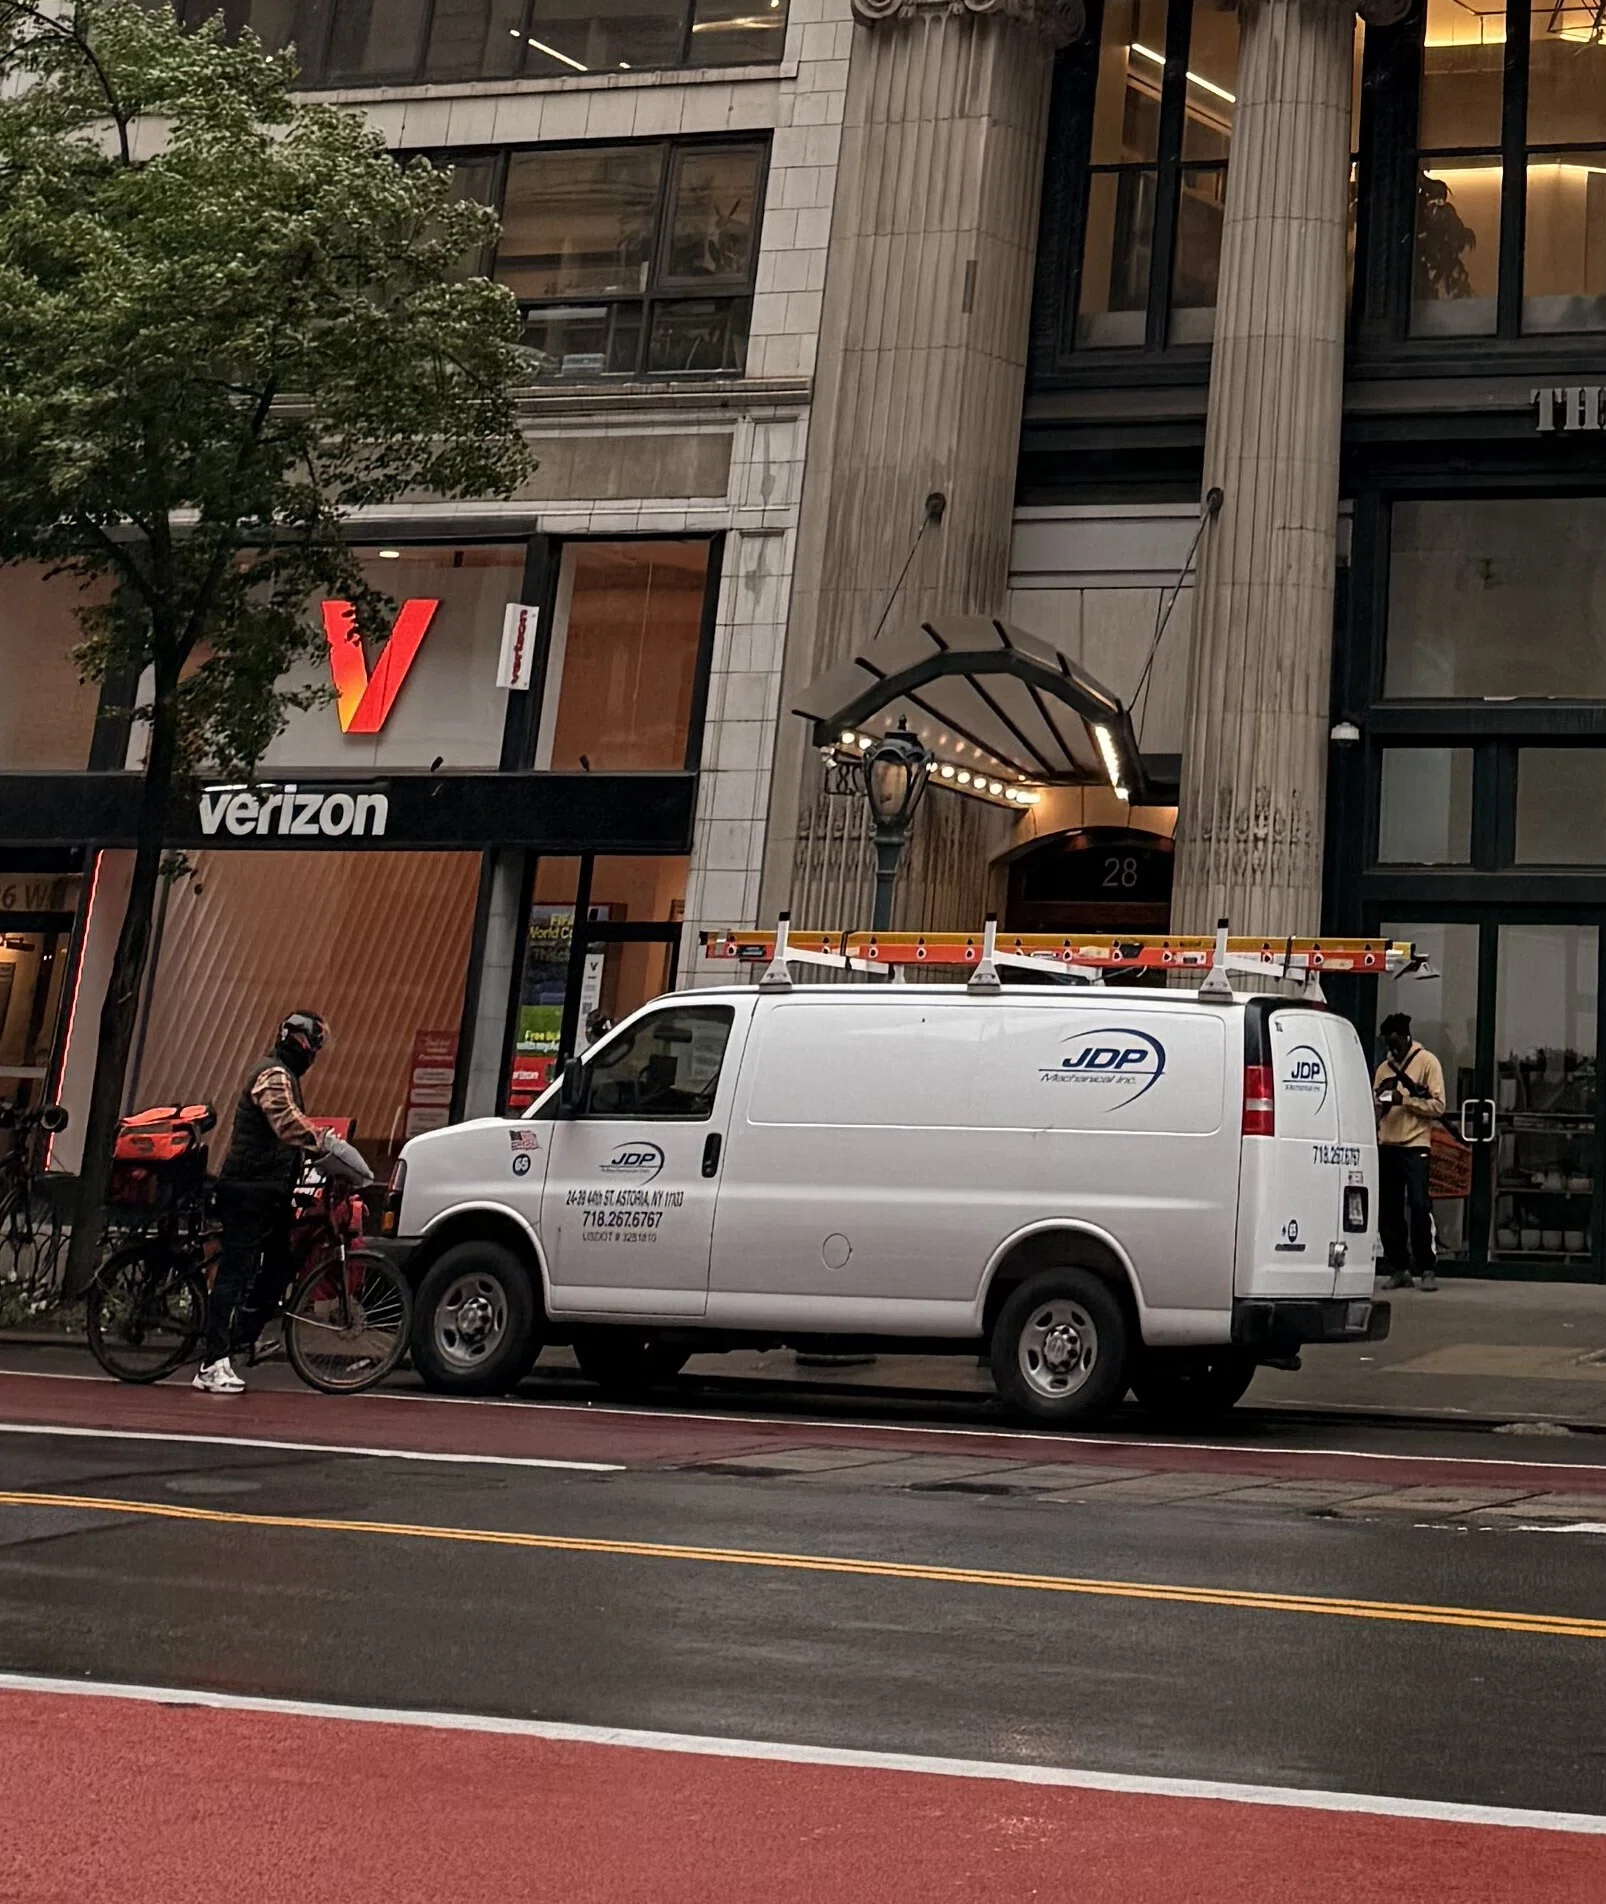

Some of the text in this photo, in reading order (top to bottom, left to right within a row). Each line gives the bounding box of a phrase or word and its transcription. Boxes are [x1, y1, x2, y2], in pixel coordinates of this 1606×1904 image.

[199, 784, 389, 836] verizon
[1102, 857, 1137, 888] 28
[1061, 1047, 1149, 1070] JDP
[1040, 1073, 1116, 1084] Mechanical
[1291, 1061, 1321, 1080] JDP
[611, 1152, 657, 1167] JDP
[651, 1190, 664, 1207] NY
[582, 1210, 664, 1229] 718.267.6767
